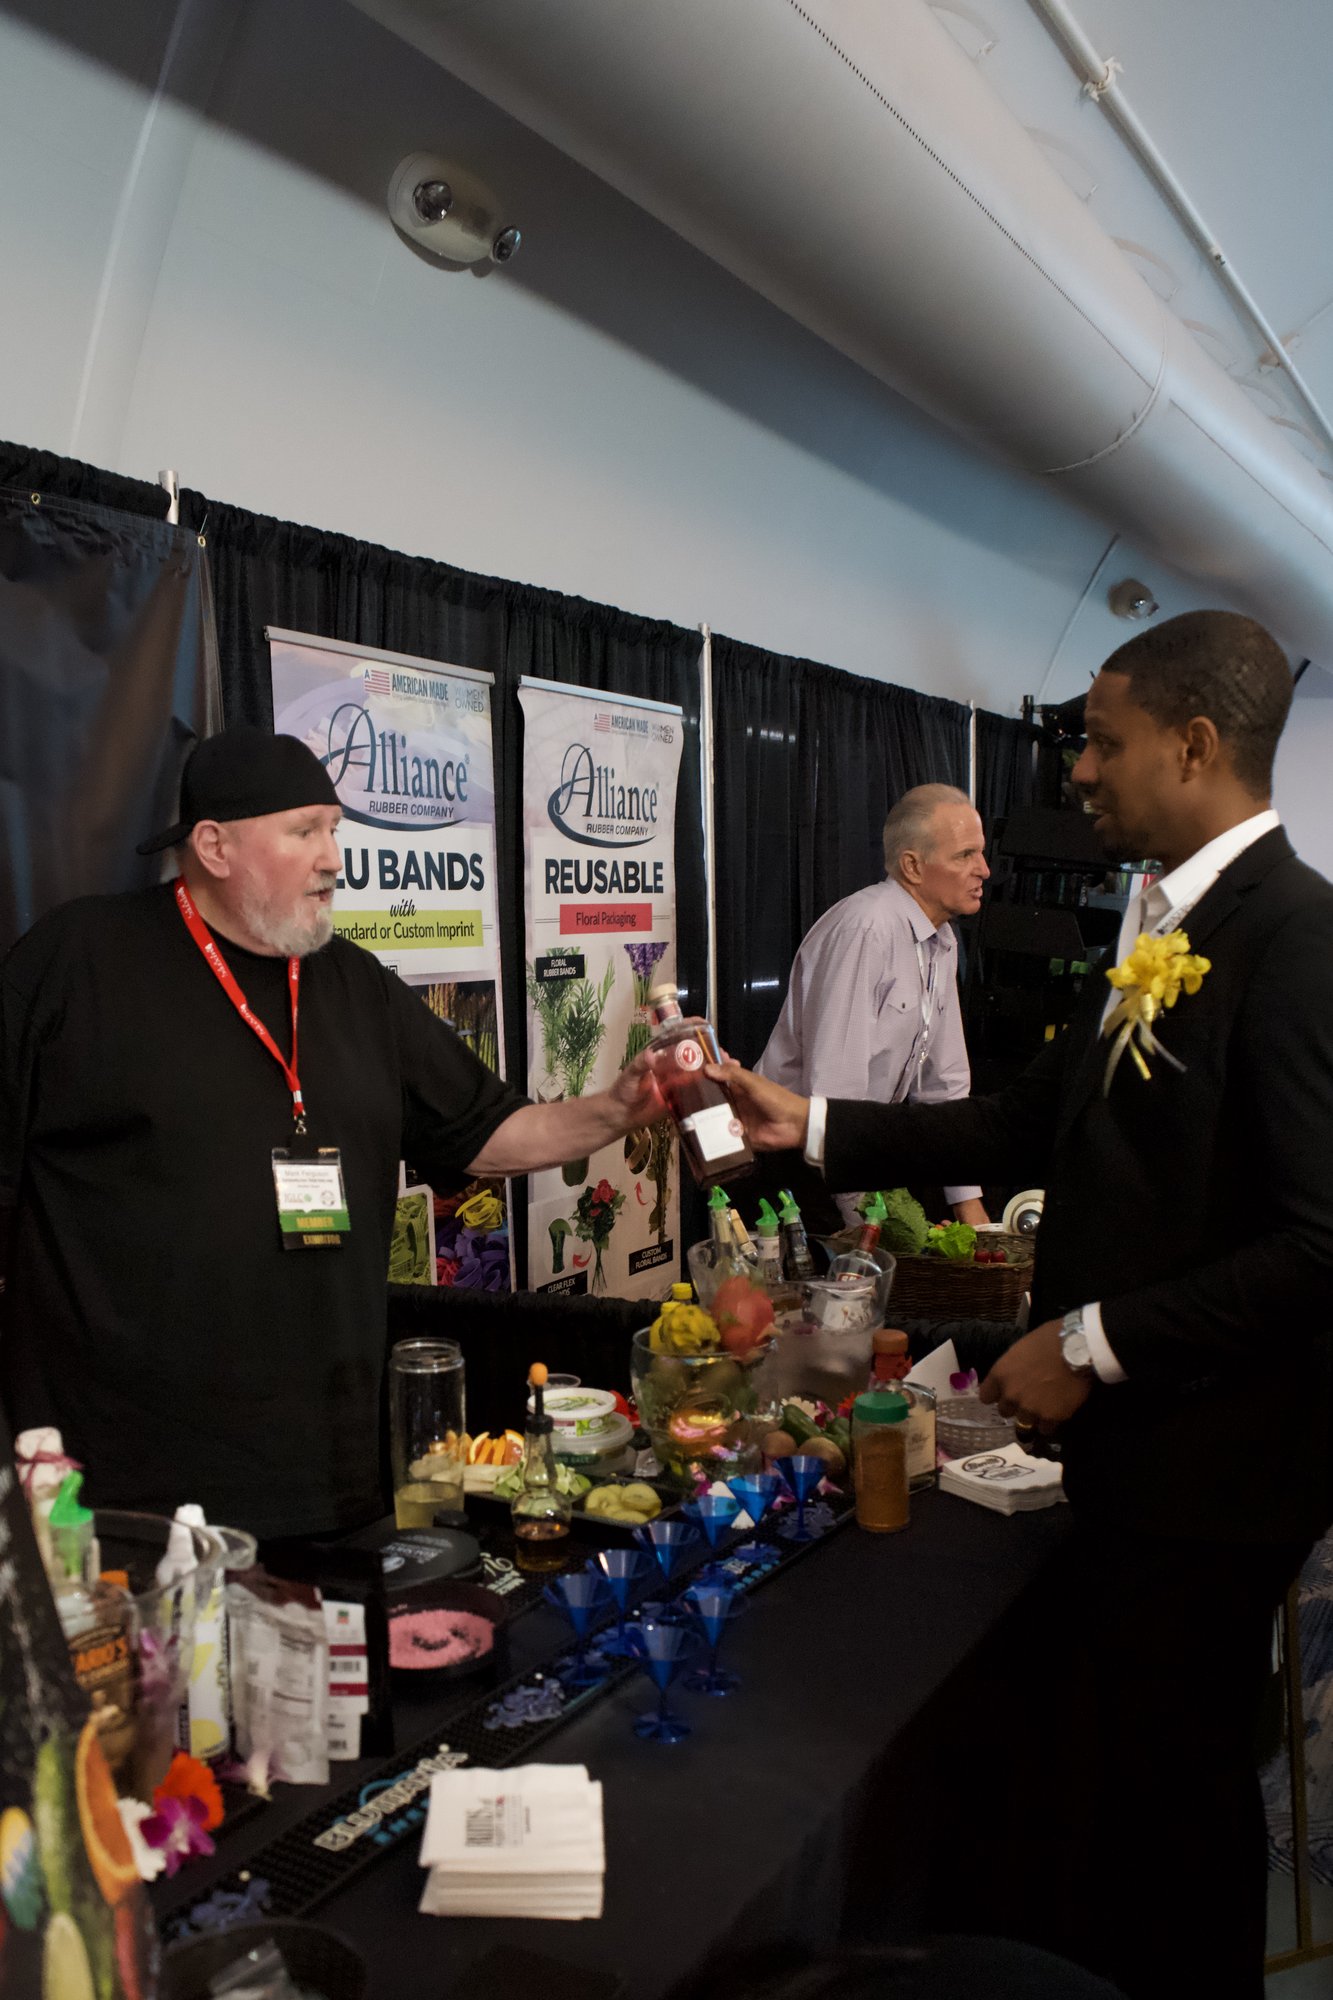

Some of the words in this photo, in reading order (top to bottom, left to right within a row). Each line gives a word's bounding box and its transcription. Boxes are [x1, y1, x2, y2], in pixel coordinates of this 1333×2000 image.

[392, 673, 429, 698] AMERICAN
[430, 680, 449, 701] MADE
[454, 697, 485, 713] OWNED
[611, 714, 636, 732] AMERICAN
[636, 719, 649, 734] MADE
[328, 703, 469, 802] Alliance
[553, 743, 658, 823] Alliance
[369, 801, 408, 815] RUBBER
[411, 803, 455, 818] COMPANY
[586, 823, 615, 835] RUBBER
[615, 825, 649, 836] COMPANY
[377, 849, 485, 892] BANDS
[545, 858, 664, 895] REUSABLE
[389, 899, 418, 918] with
[575, 911, 601, 926] Floral
[601, 911, 637, 928] Packaging
[333, 921, 378, 940] tandard
[379, 927, 391, 939] or
[393, 922, 435, 939] Custom
[436, 921, 475, 940] Imprint
[543, 968, 560, 977] RUBBER
[560, 966, 577, 976] BANDS
[550, 957, 568, 967] FLORAL
[635, 1257, 653, 1270] FLORAL
[652, 1251, 668, 1263] BANDS
[641, 1246, 662, 1259] CUSTOM
[547, 1281, 564, 1294] CLEAR
[563, 1277, 576, 1287] FLEX
